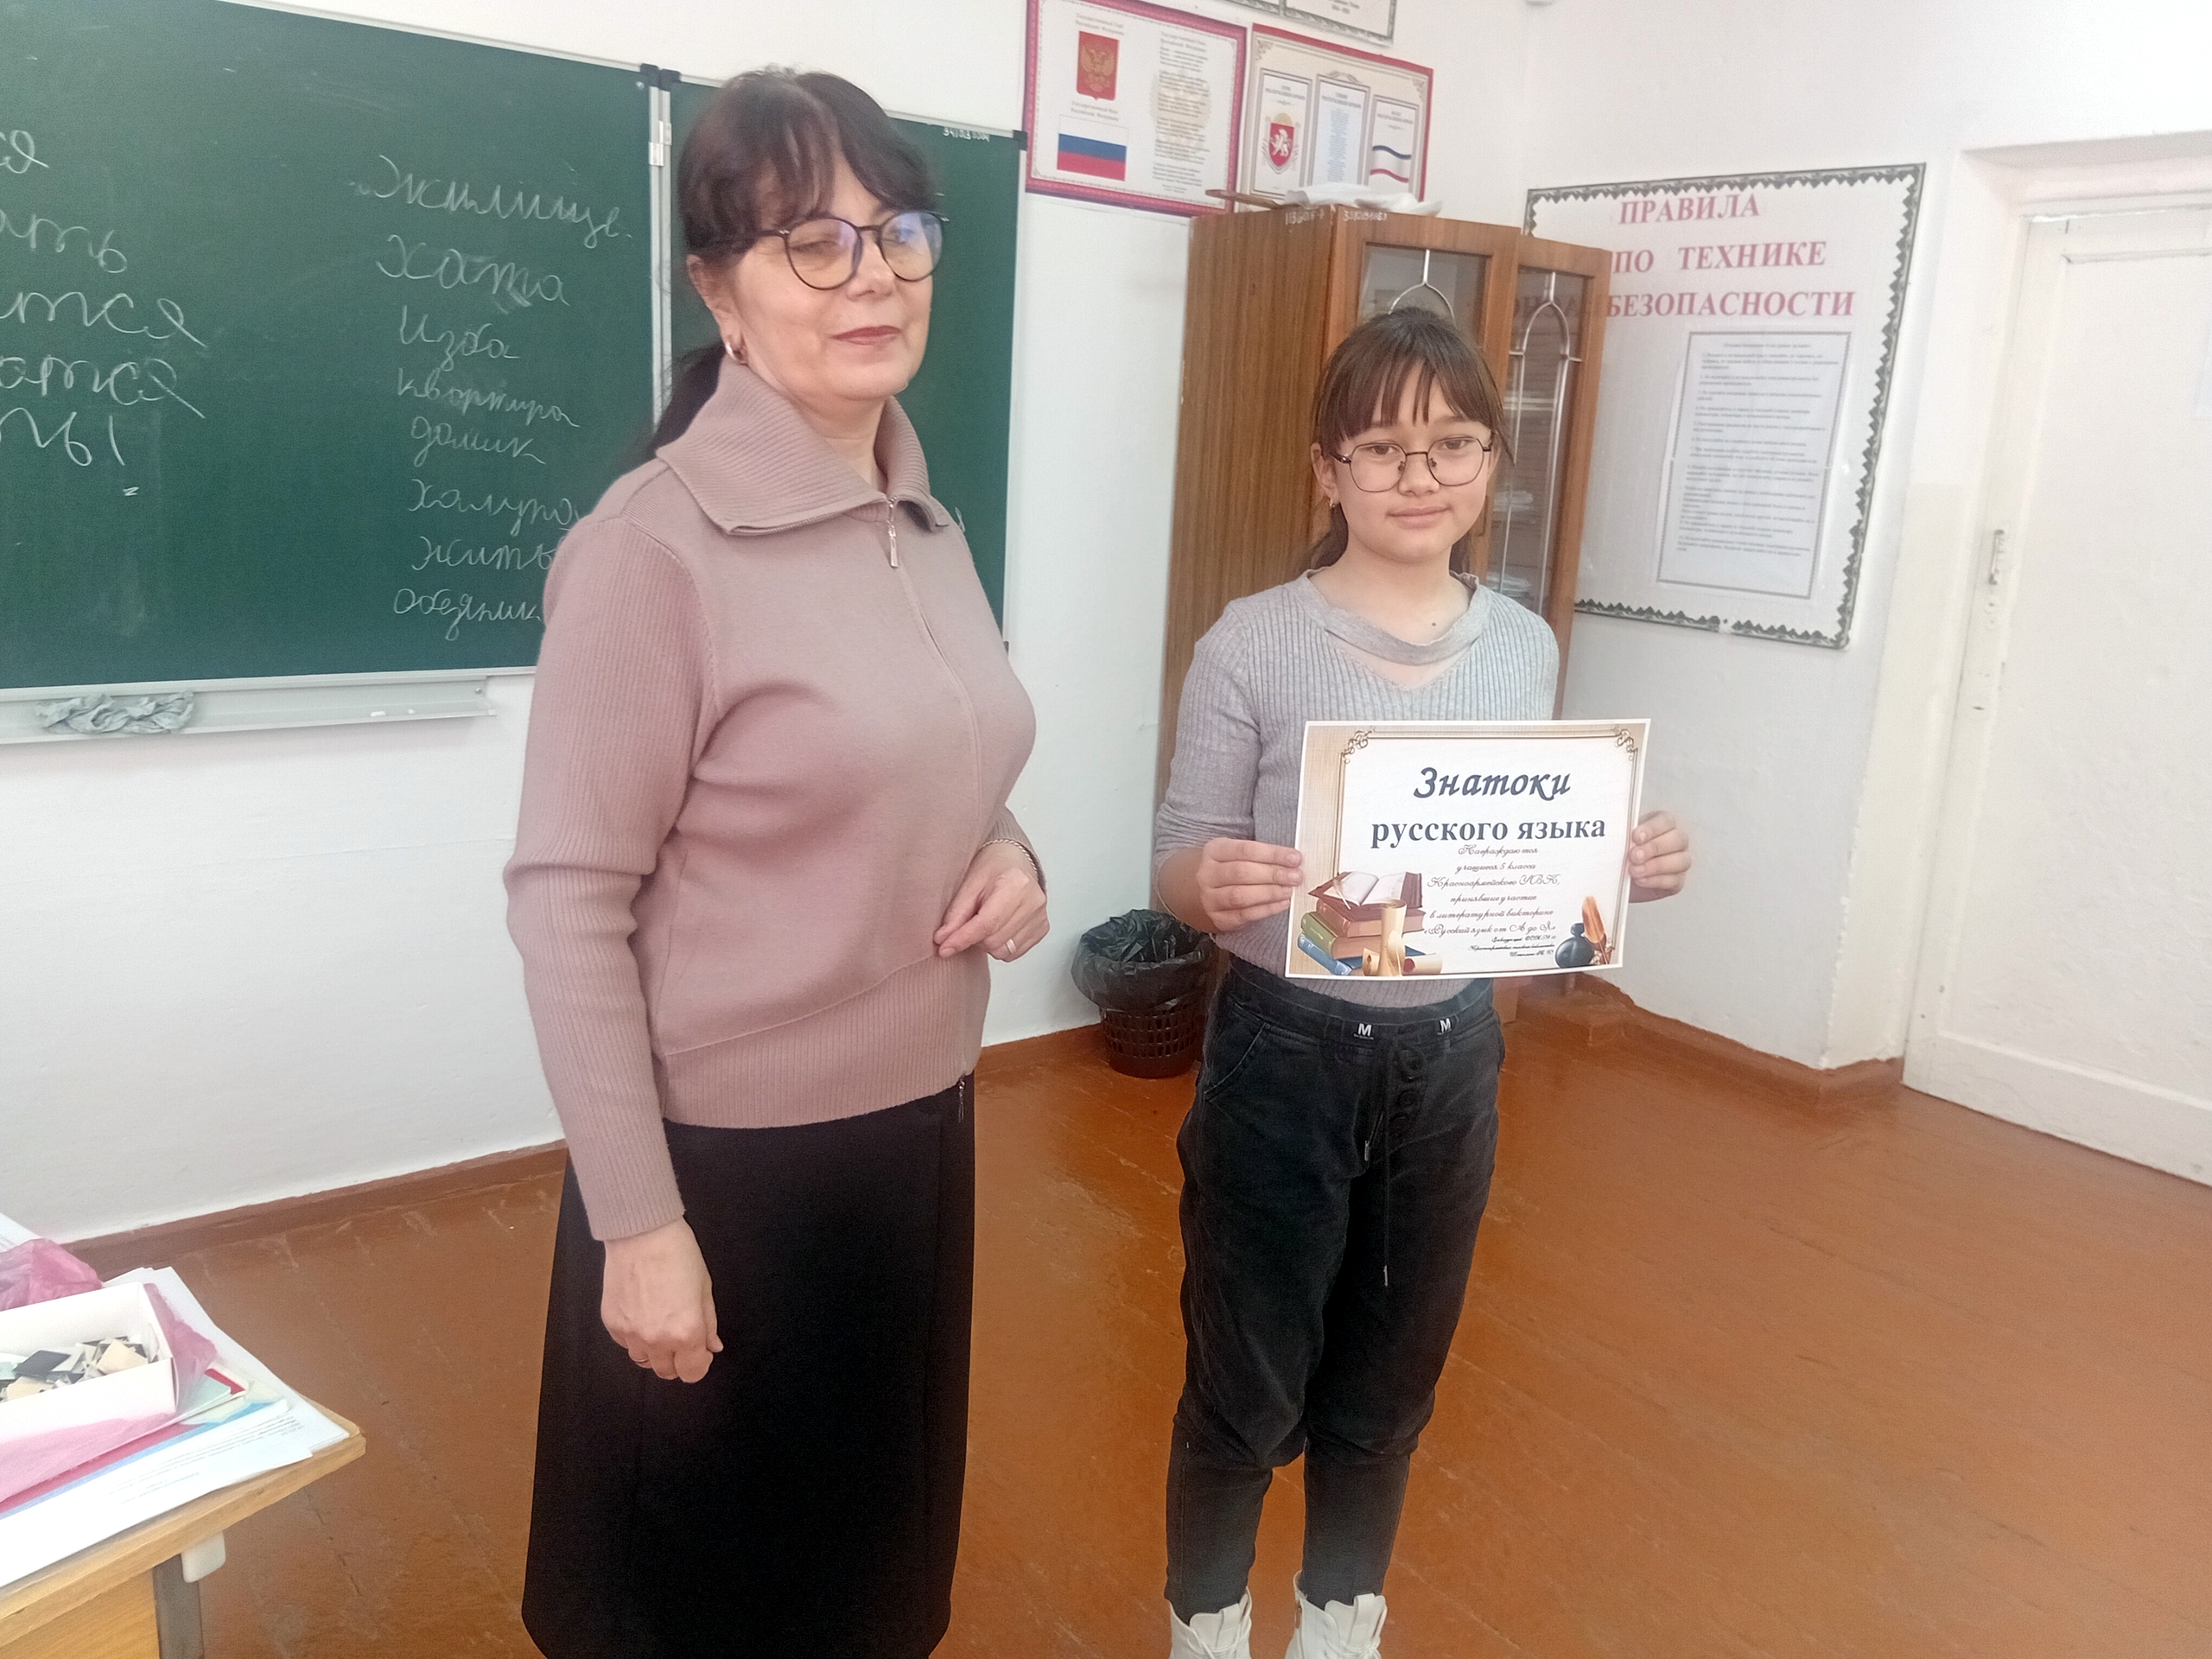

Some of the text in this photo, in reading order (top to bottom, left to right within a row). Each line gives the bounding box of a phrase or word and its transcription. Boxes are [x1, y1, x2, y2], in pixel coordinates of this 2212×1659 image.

[1618, 194, 1760, 225] ПРАВИЛА
[1612, 241, 1827, 274] ПО ТЕХНИКЕ
[1606, 290, 1856, 318] БЕЗОПАСНОСТИ
[1413, 766, 1572, 802] Знатоки
[1370, 819, 1606, 849] русского языка
[1499, 862, 1507, 871] 5
[1507, 861, 1536, 871] класса
[1429, 909, 1438, 919] в
[1506, 907, 1554, 919] викторине
[1357, 1022, 1372, 1037] M
[1439, 1017, 1452, 1032] M
